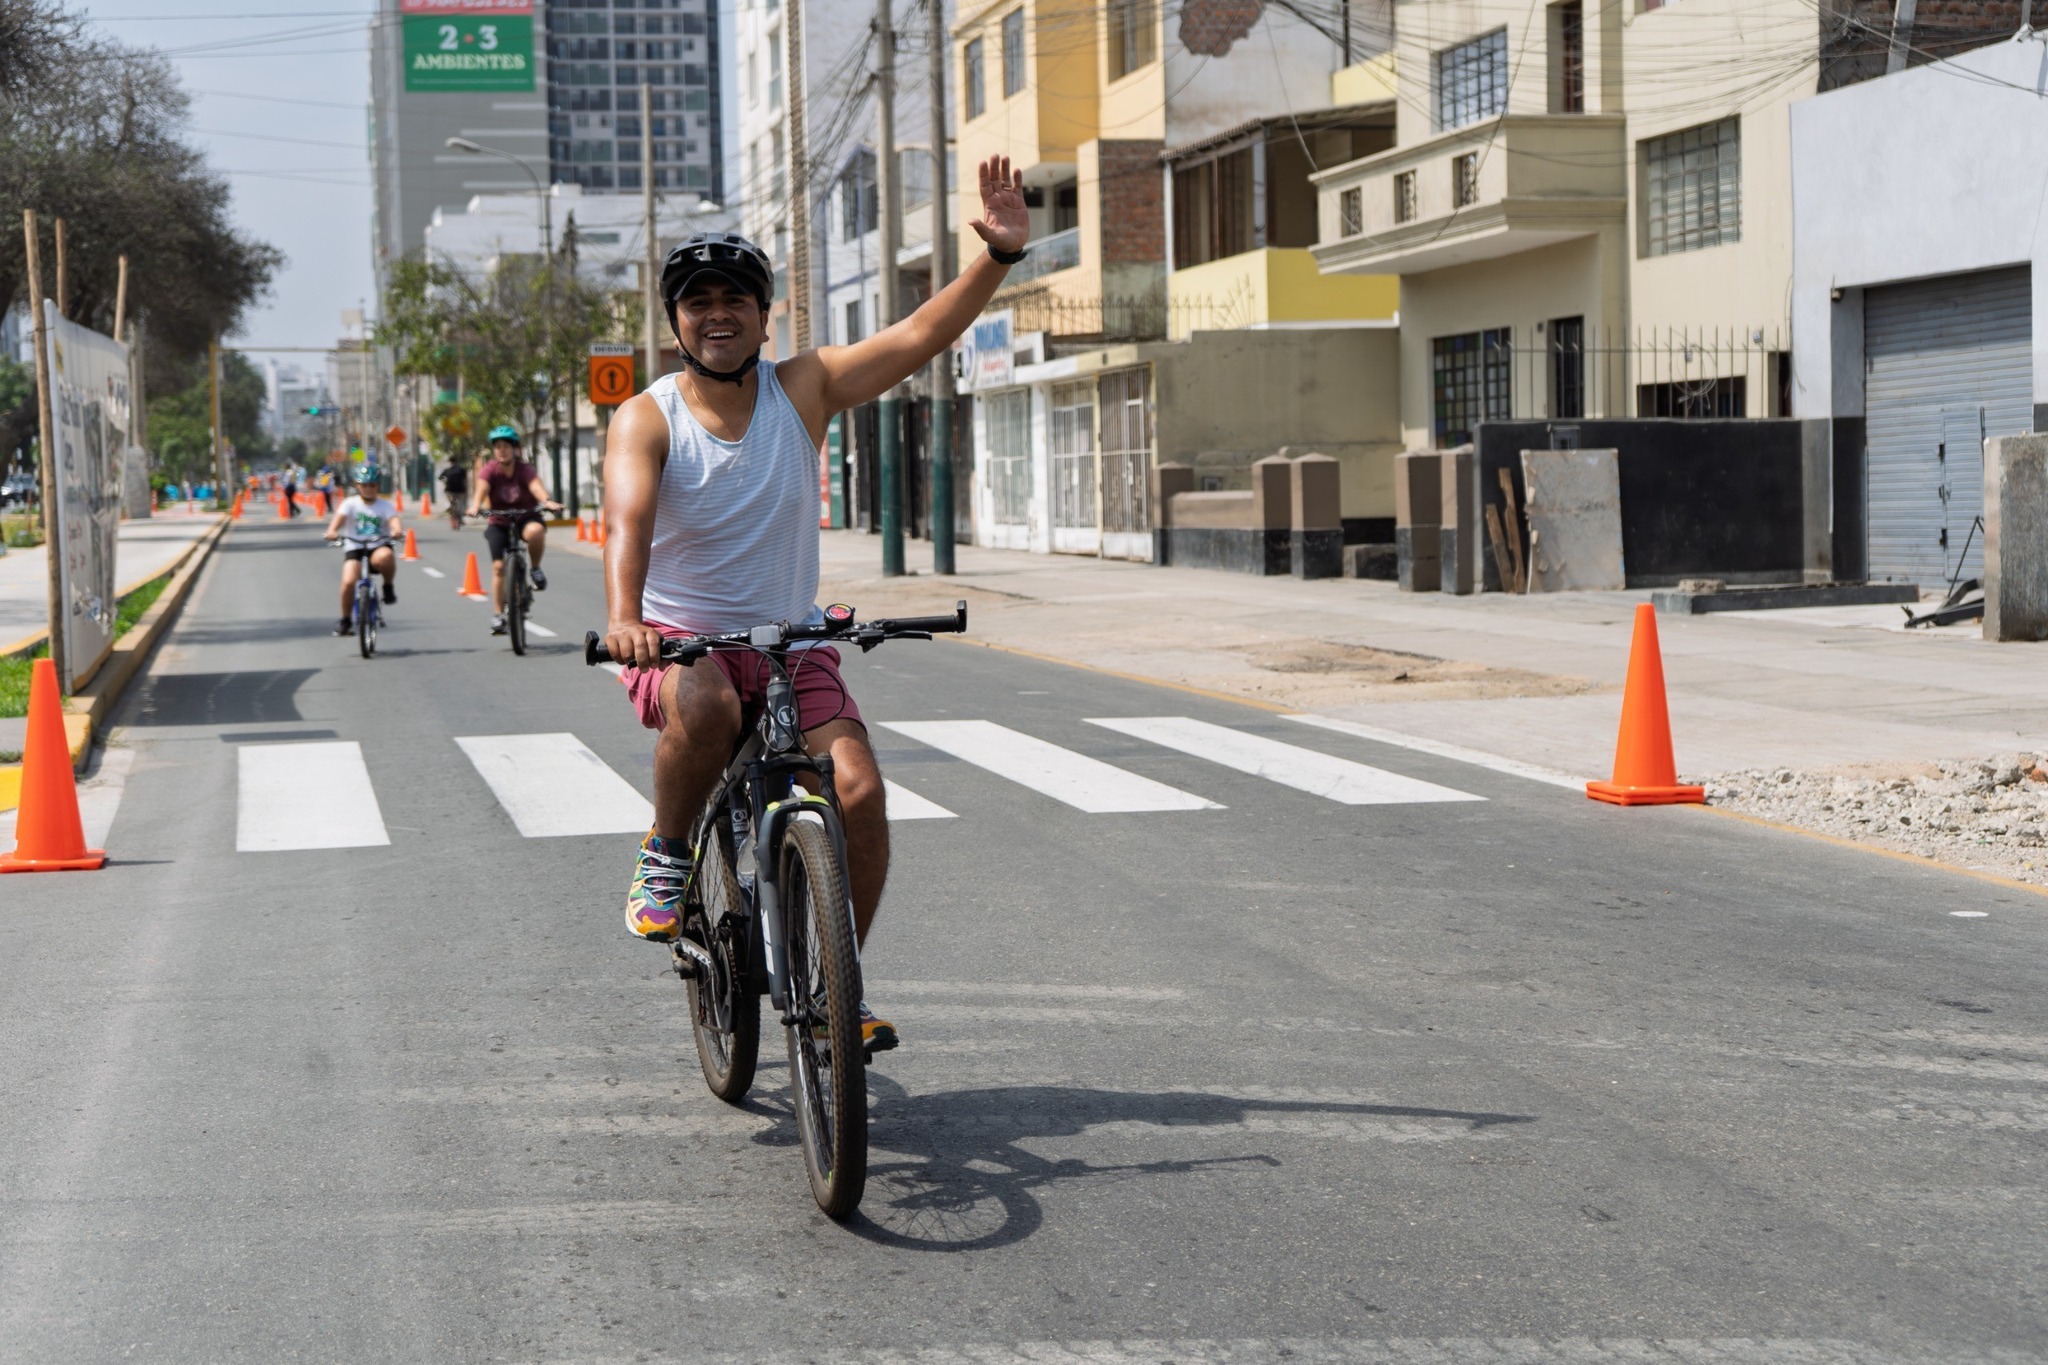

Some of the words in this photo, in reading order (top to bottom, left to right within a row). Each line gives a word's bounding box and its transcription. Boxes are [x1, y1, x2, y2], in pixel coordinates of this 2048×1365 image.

[438, 24, 459, 50] 2
[478, 24, 498, 50] 3
[413, 53, 526, 70] AMBIENTES
